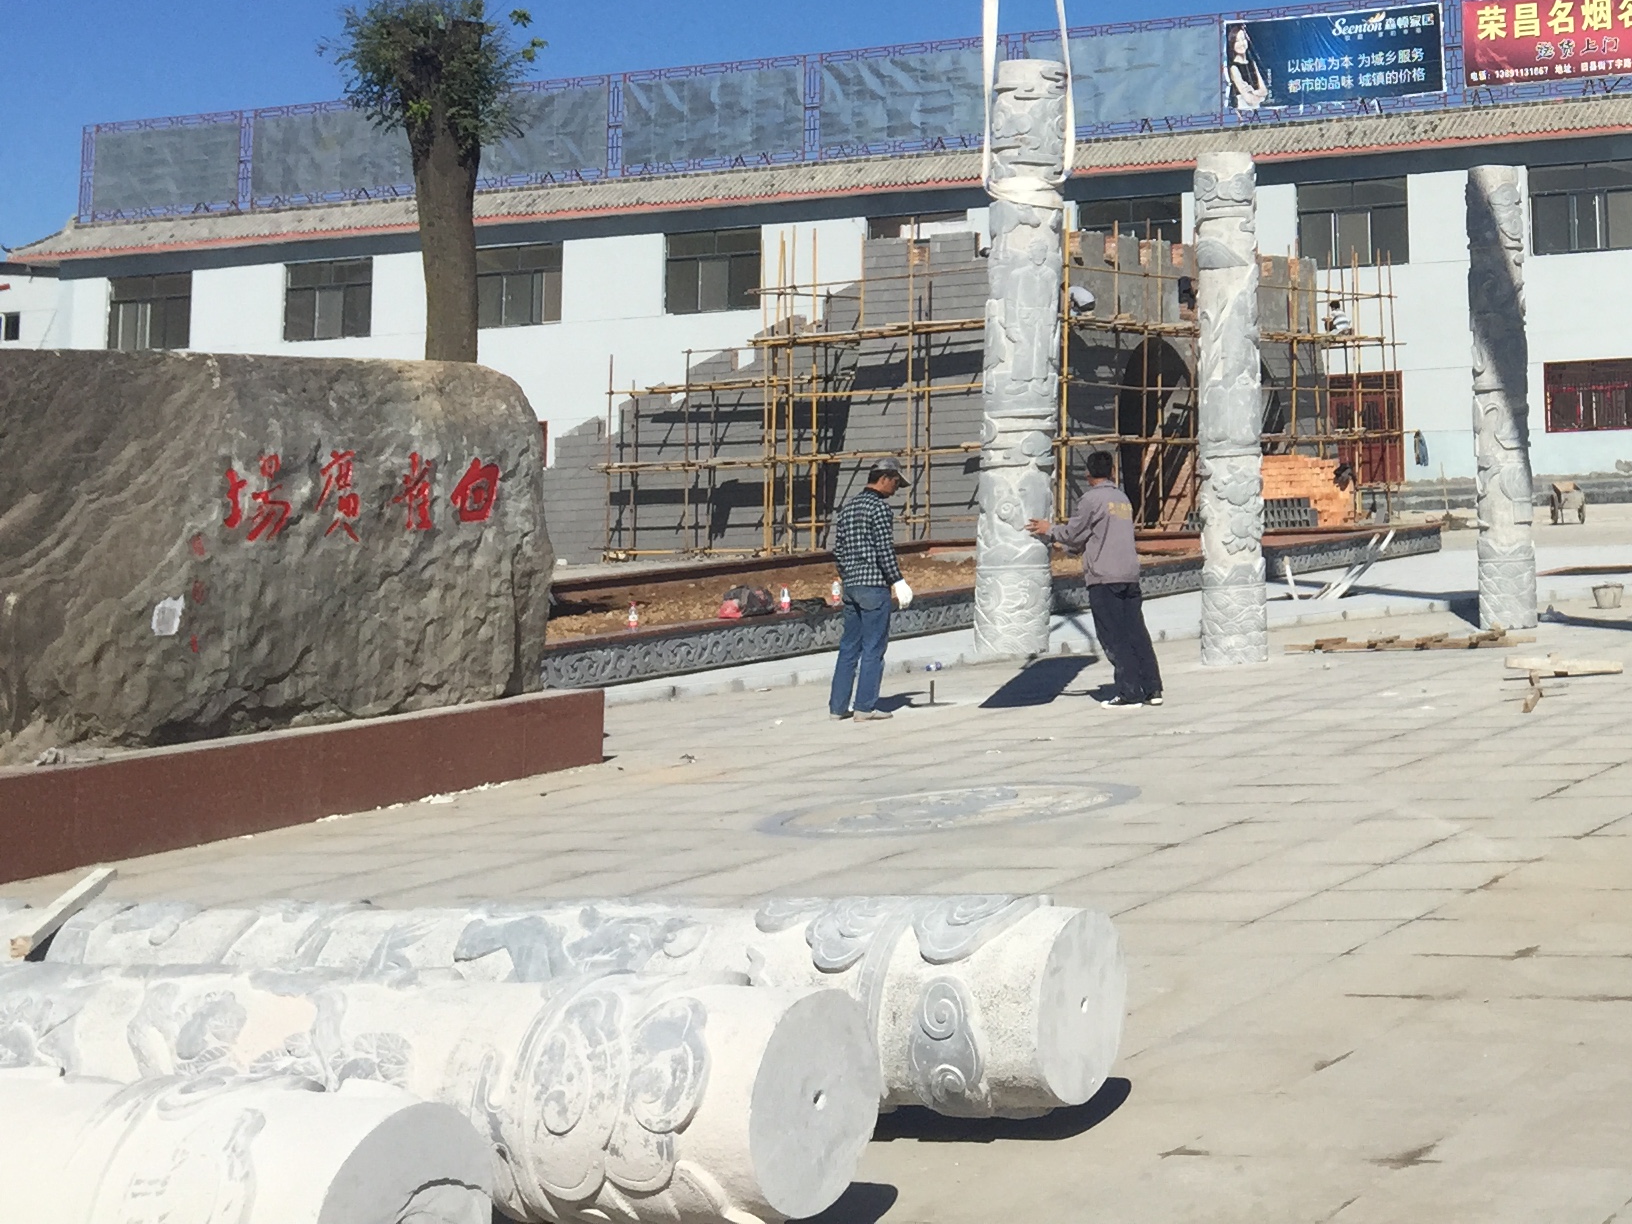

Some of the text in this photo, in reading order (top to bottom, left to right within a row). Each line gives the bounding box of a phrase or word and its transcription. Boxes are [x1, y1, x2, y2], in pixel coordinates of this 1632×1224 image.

[1287, 47, 1425, 73] 以诚信为本 为城乡服务
[1535, 36, 1619, 61] 送货上门
[1287, 76, 1354, 94] 都市的品味
[1358, 67, 1426, 88] 城镇的价格
